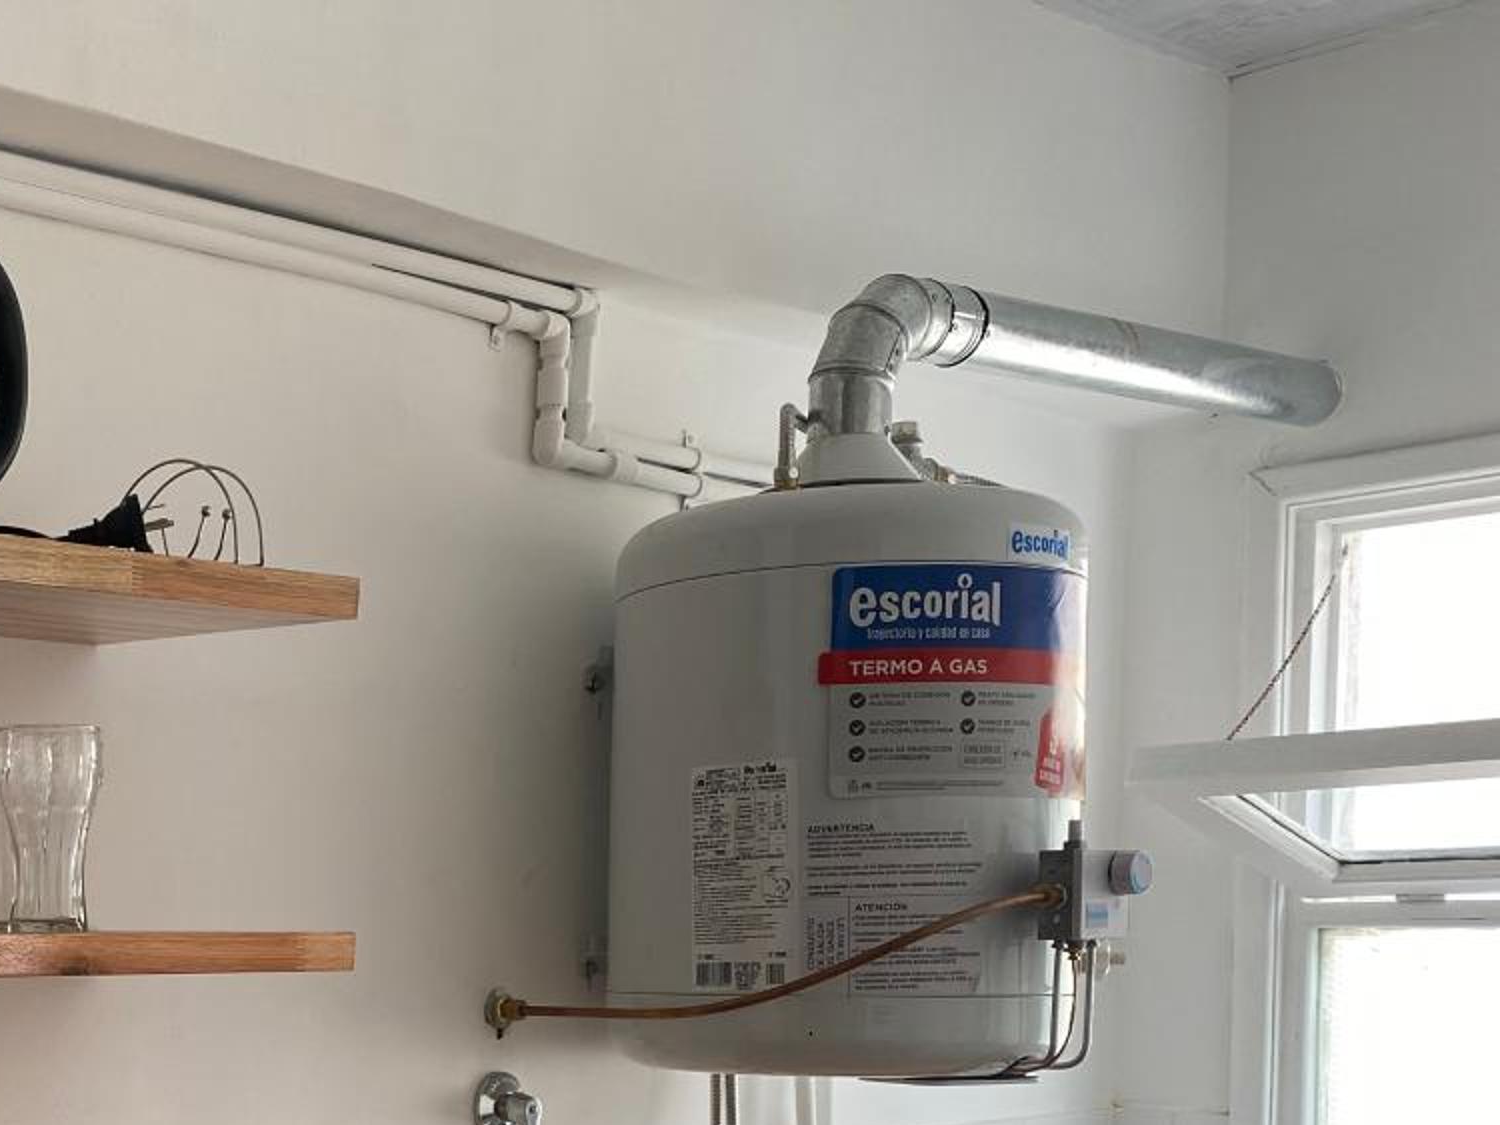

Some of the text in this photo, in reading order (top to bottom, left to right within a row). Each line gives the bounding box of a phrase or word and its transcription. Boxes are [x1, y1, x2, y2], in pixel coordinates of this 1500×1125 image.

[1012, 530, 1068, 560] escorial
[851, 573, 1000, 627] escorial
[850, 659, 988, 677] TERMO A GAS
